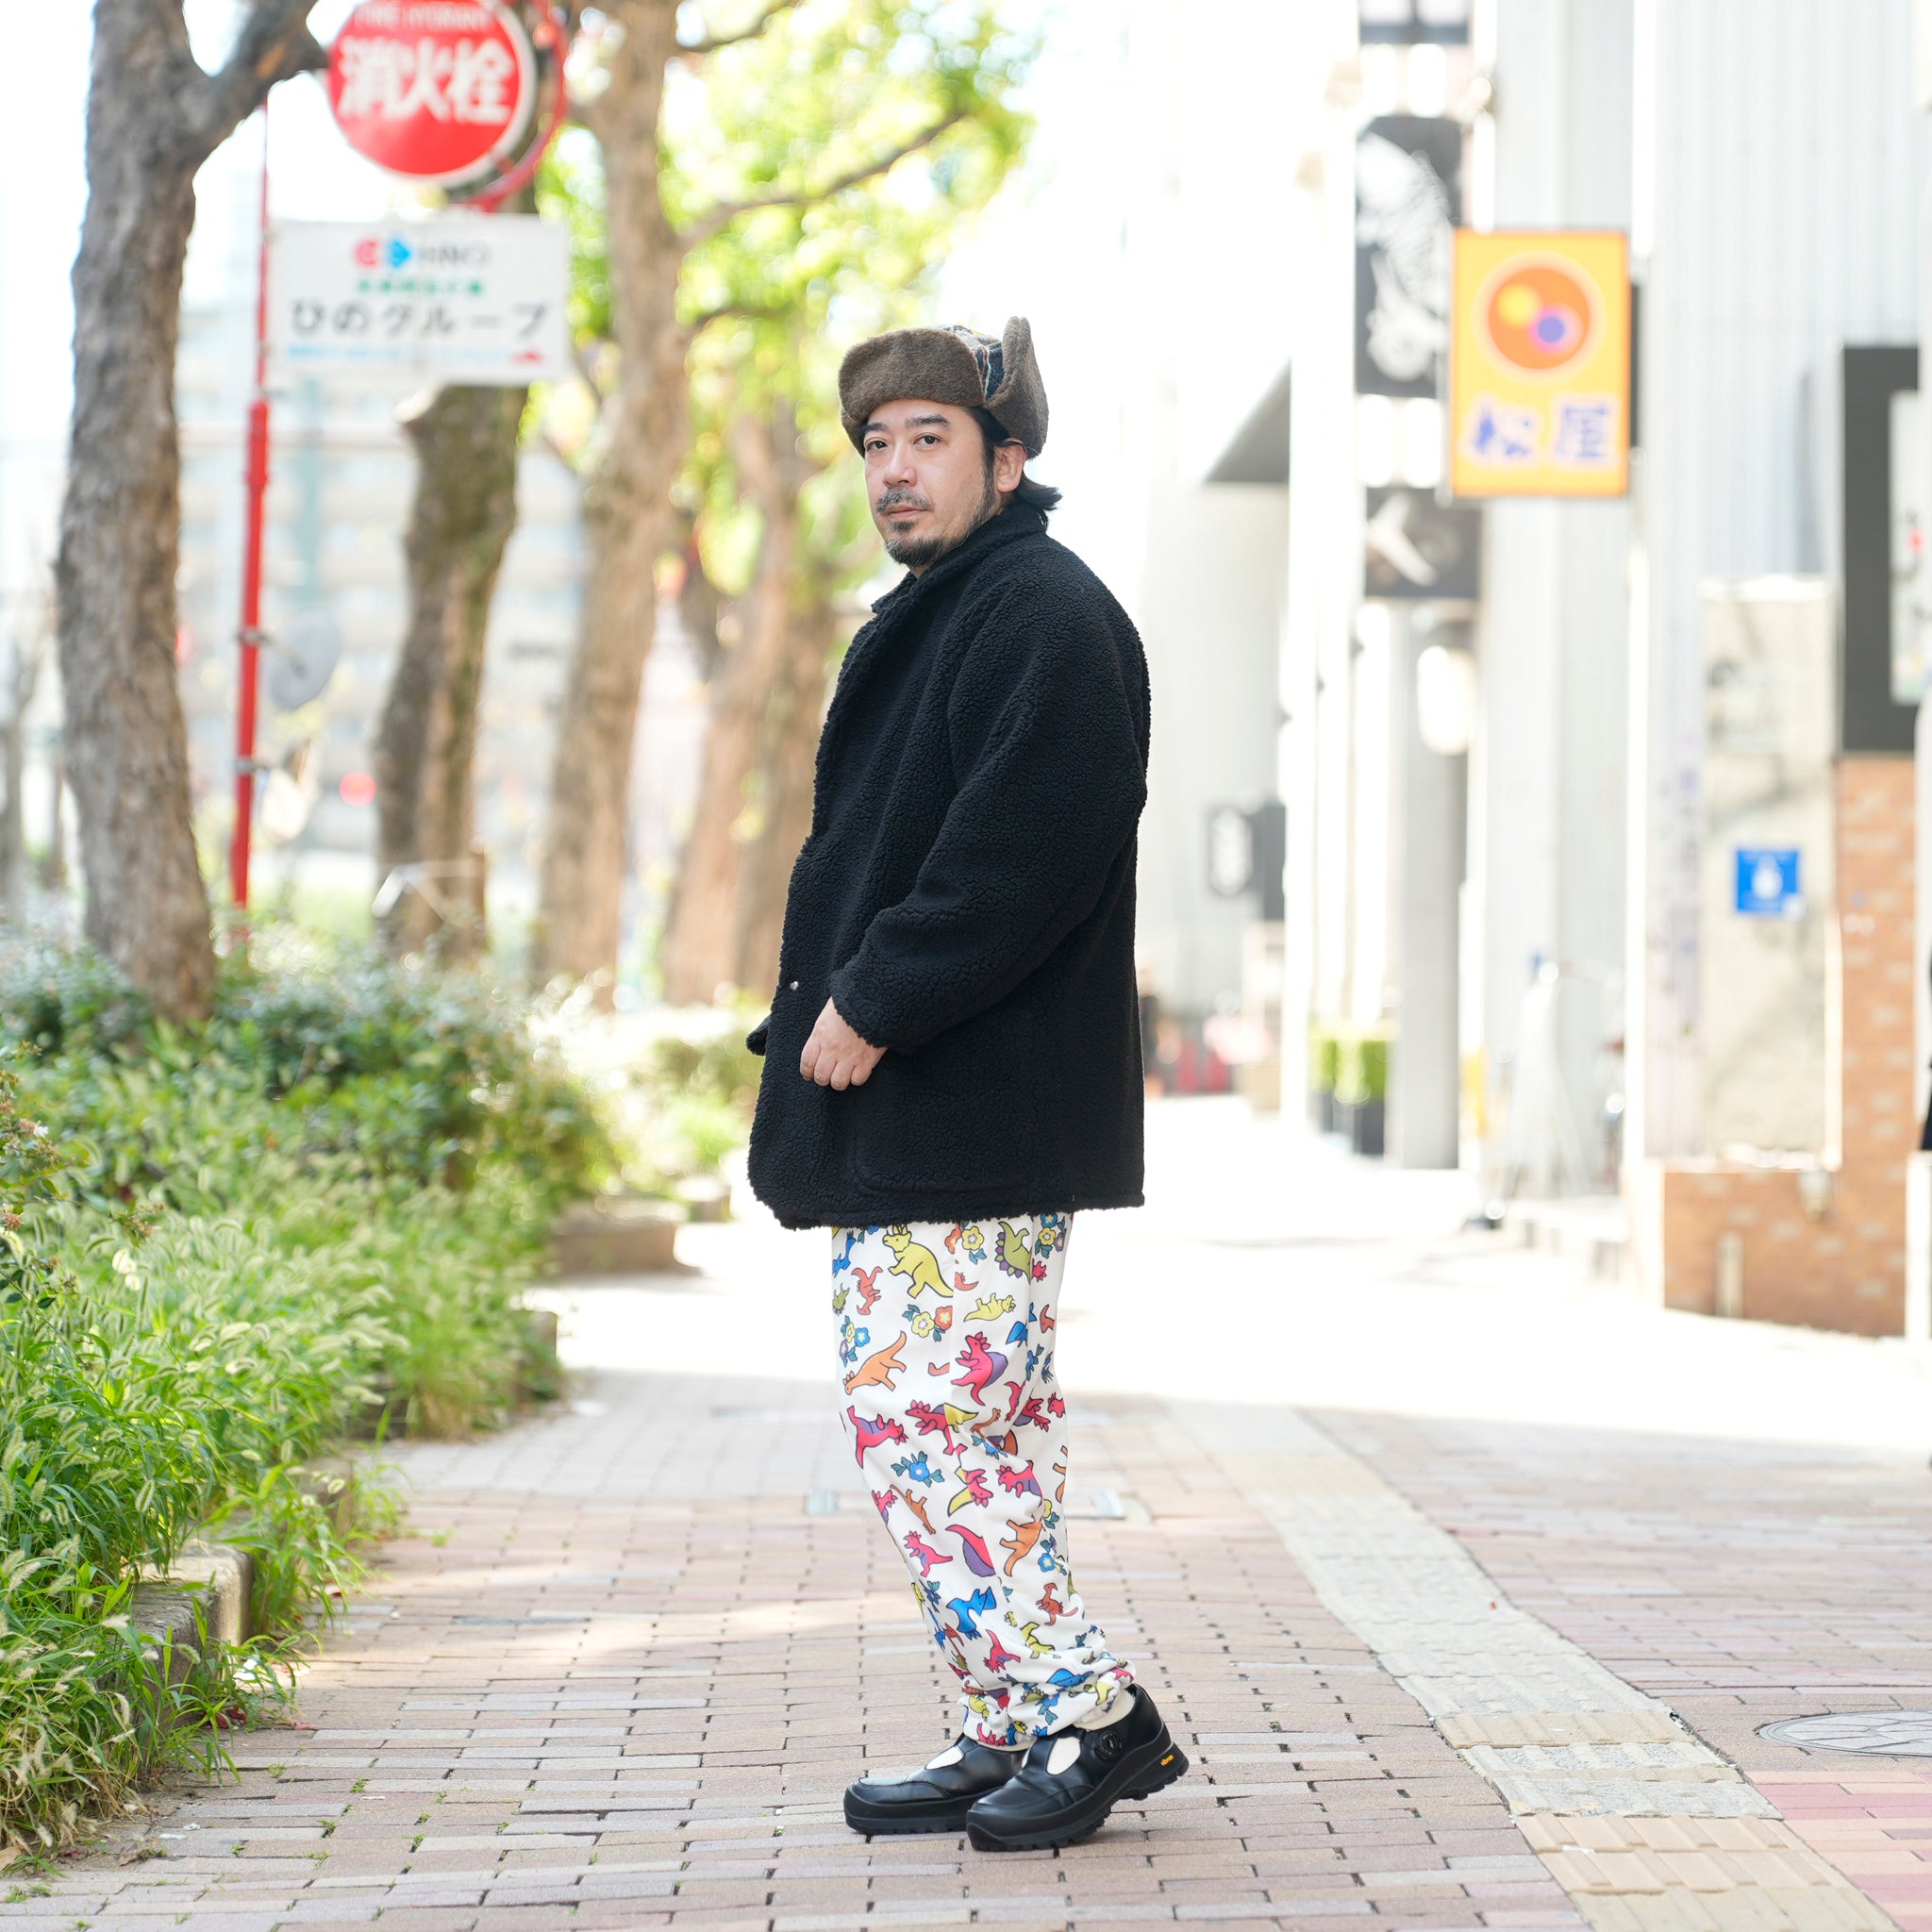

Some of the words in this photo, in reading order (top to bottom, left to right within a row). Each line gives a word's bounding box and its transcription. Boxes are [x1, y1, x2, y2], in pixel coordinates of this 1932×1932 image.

[338, 36, 515, 125] 消火栓
[1468, 400, 1612, 460] 松屋
